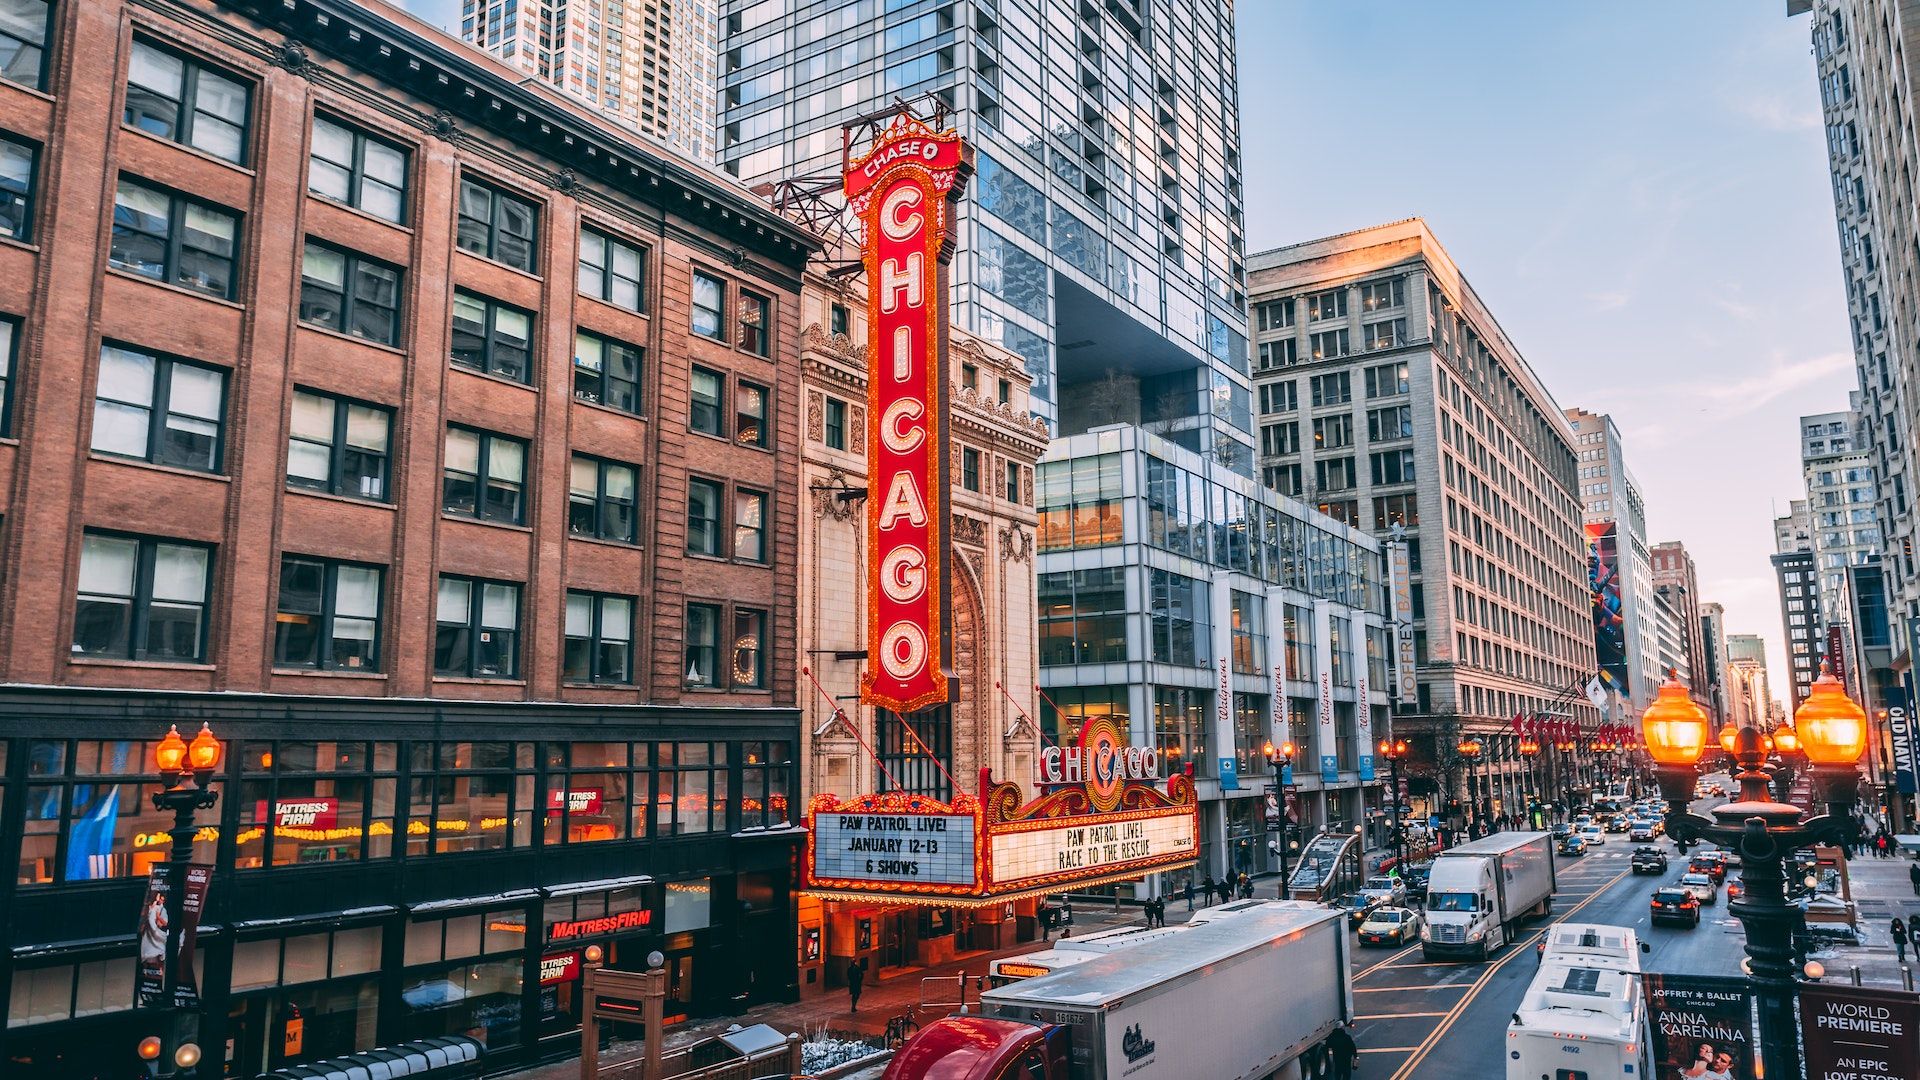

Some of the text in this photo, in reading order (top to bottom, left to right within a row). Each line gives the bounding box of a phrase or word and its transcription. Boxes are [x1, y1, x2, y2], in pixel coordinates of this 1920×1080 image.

[864, 141, 921, 178] CHASE
[879, 185, 928, 681] CHICAGO
[1393, 544, 1417, 701] JOFFREY BALLET
[1218, 656, 1231, 722] Walgreens
[1273, 664, 1286, 725] Walgreens
[1320, 671, 1332, 726] Walgreens
[1359, 677, 1370, 729] Walgreens
[1890, 706, 1912, 773] OLD NAVY
[1042, 746, 1158, 782] CHICAGO
[555, 791, 597, 802] MTTRESS
[568, 800, 589, 810] IRM
[280, 812, 316, 826] FIRM
[839, 815, 947, 832] PAW PATROL LIVE!
[1067, 822, 1143, 848] PAW PATROL LIVE!
[847, 837, 938, 854] JANUARY 12-13
[1059, 839, 1150, 870] RACE TO THE RESCUE
[866, 859, 919, 876] 6 SHOWS
[540, 955, 574, 969] TTRESS
[540, 965, 565, 980] FIRM
[1653, 989, 1742, 1001] JOFFREY BALLET
[1056, 1013, 1084, 1024] 161675
[1658, 1011, 1708, 1026] ANNA
[1826, 1002, 1890, 1020] WORLD
[1660, 1023, 1746, 1043] KARENINA
[1817, 1015, 1903, 1036] PREMIERE
[286, 1031, 298, 1044] M
[1561, 1045, 1580, 1054] 4192
[1836, 1057, 1889, 1071] AN EPIC
